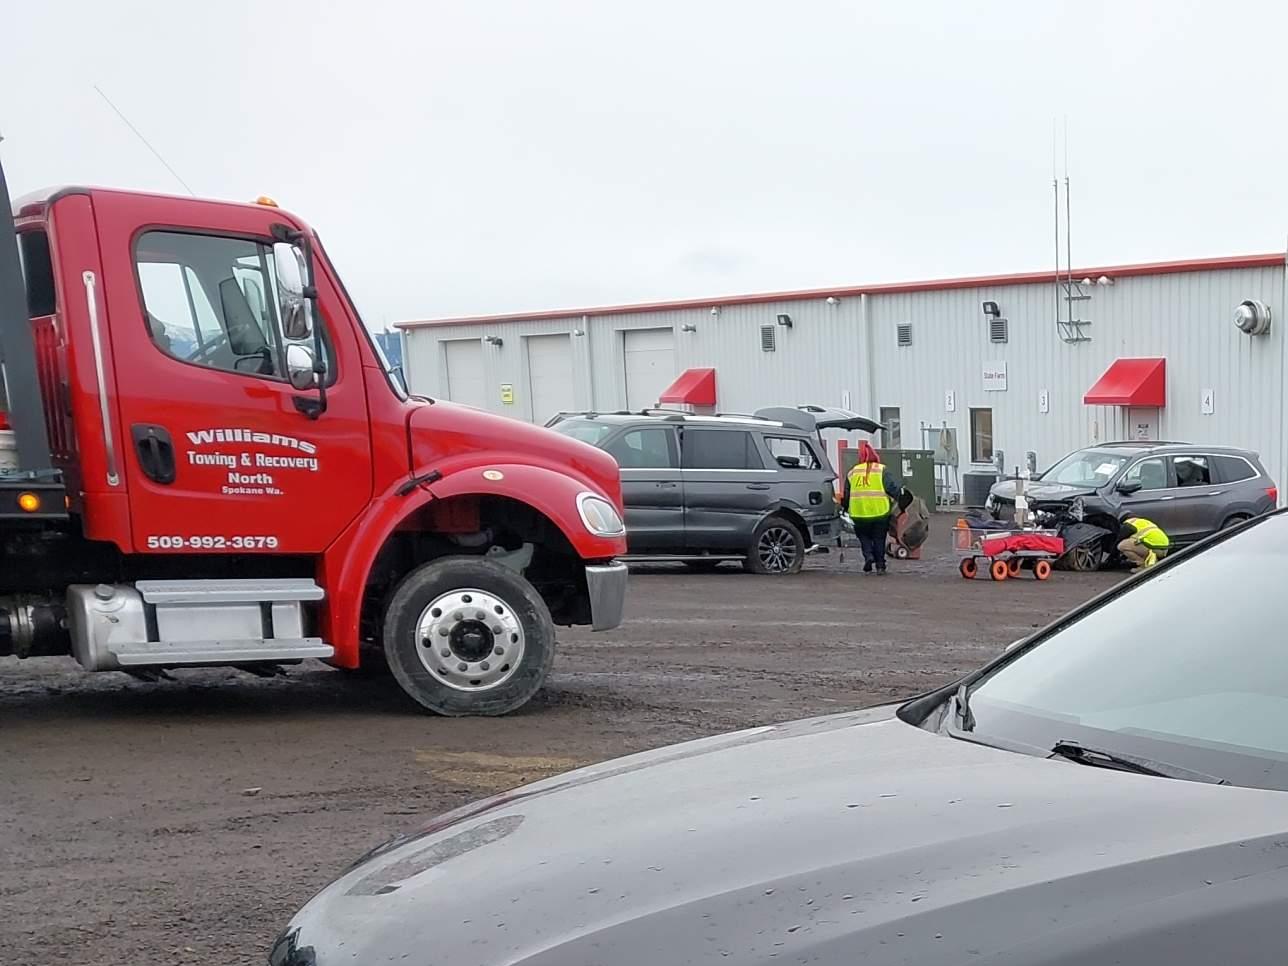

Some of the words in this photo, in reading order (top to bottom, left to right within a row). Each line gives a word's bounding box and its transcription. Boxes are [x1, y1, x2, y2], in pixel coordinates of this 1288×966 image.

[1205, 395, 1210, 407] 4
[187, 428, 316, 454] Williams
[187, 451, 236, 468] Towing
[241, 453, 252, 467] &
[256, 453, 318, 471] Recovery
[228, 473, 273, 484] North
[222, 486, 263, 495] Spokane
[266, 486, 284, 495] Wa.
[148, 536, 278, 548] 509-992-3679
